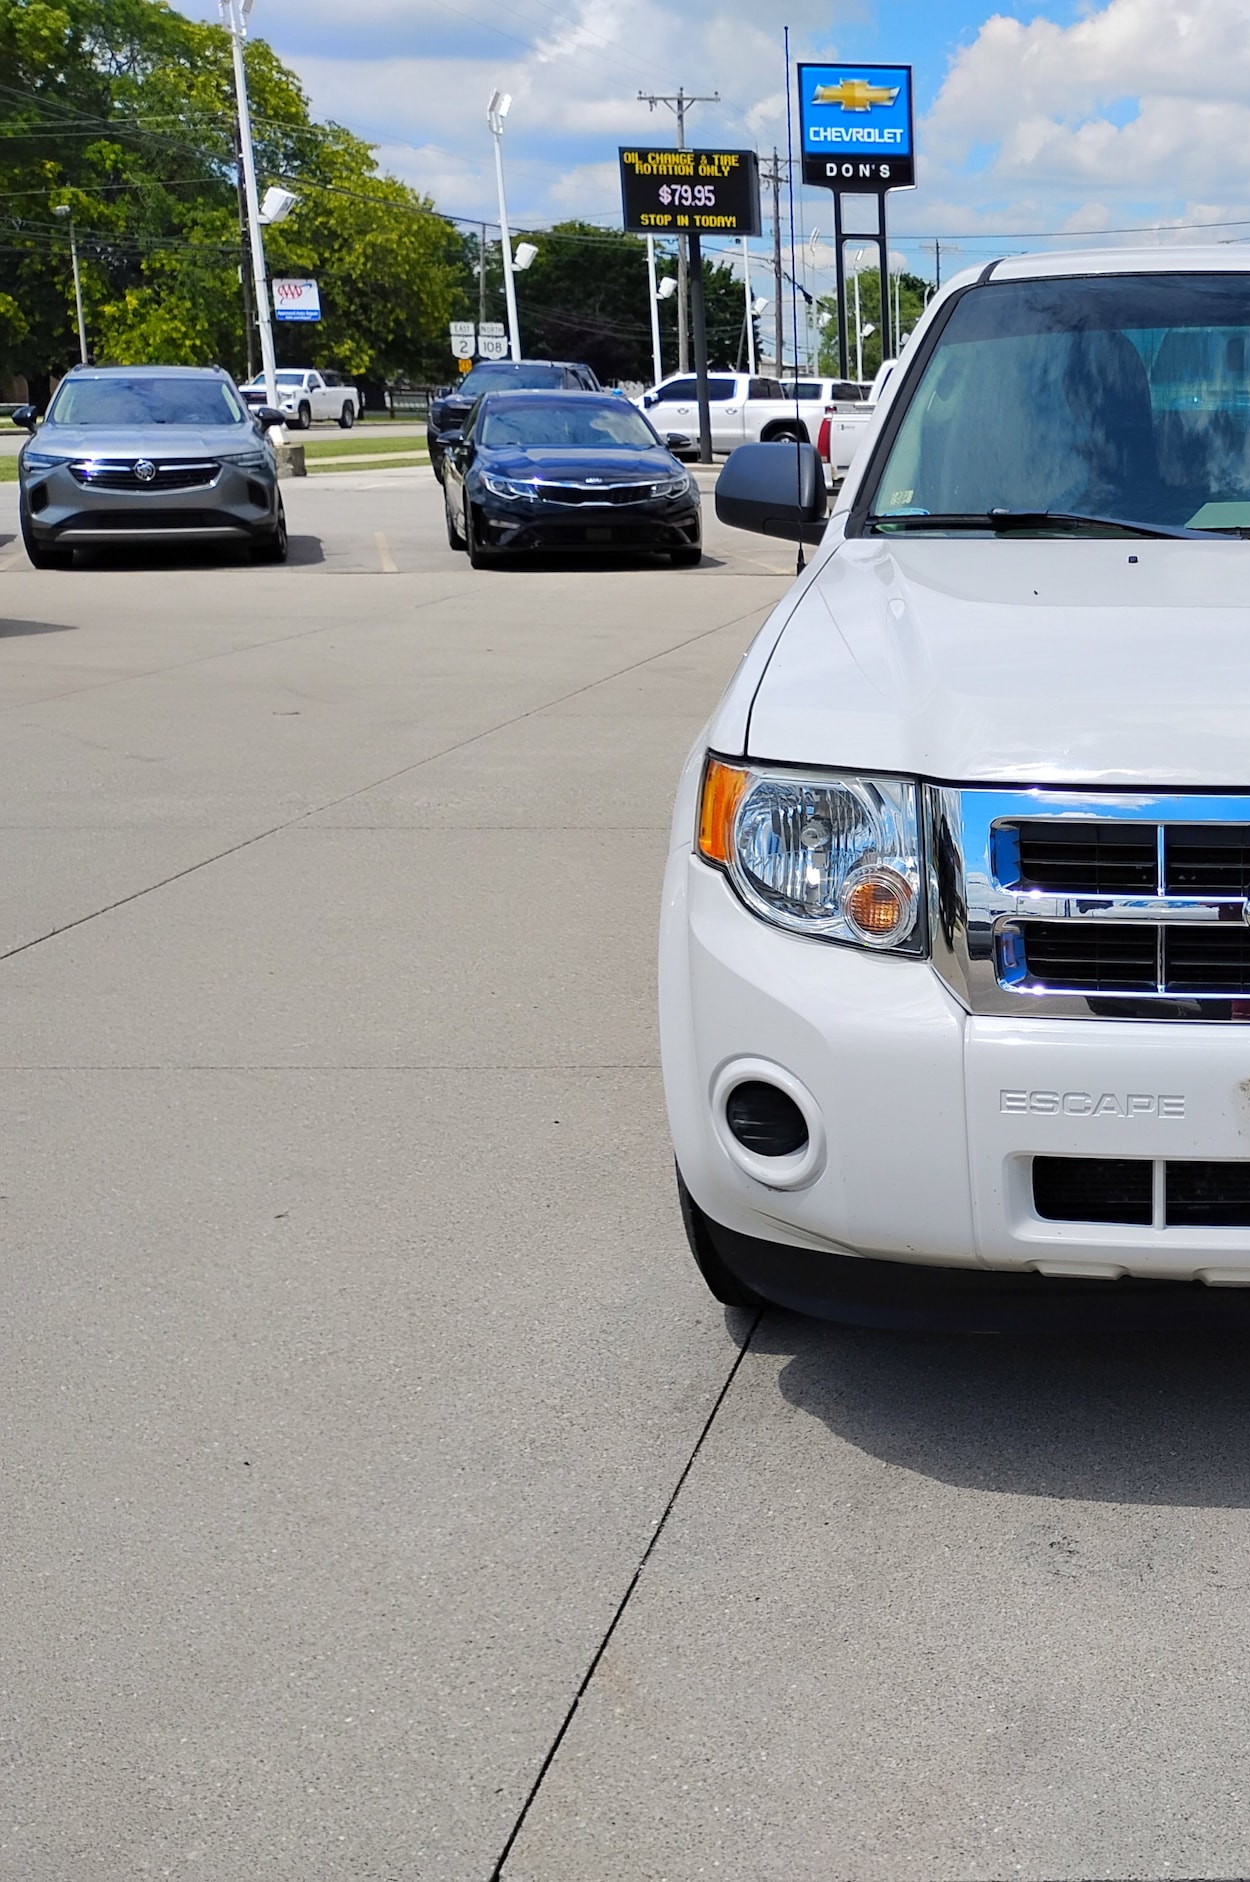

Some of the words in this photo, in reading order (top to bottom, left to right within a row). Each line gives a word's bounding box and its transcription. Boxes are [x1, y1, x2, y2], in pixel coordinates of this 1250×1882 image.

[809, 127, 904, 143] CHEVROLET
[623, 152, 642, 164] OIL
[647, 152, 695, 165] CHANGE
[712, 154, 740, 167] TIRE
[635, 163, 694, 176] ROTATION
[698, 165, 730, 177] ONLY
[825, 162, 891, 178] DON'S
[658, 184, 716, 207] $79.95
[640, 213, 673, 226] STOP
[676, 214, 689, 227] IN
[693, 215, 737, 228] TODAY!
[278, 284, 302, 299] AAA
[454, 324, 470, 333] EAST
[460, 340, 469, 354] 2
[483, 341, 502, 354] 108
[999, 1089, 1185, 1119] ESCAPE
